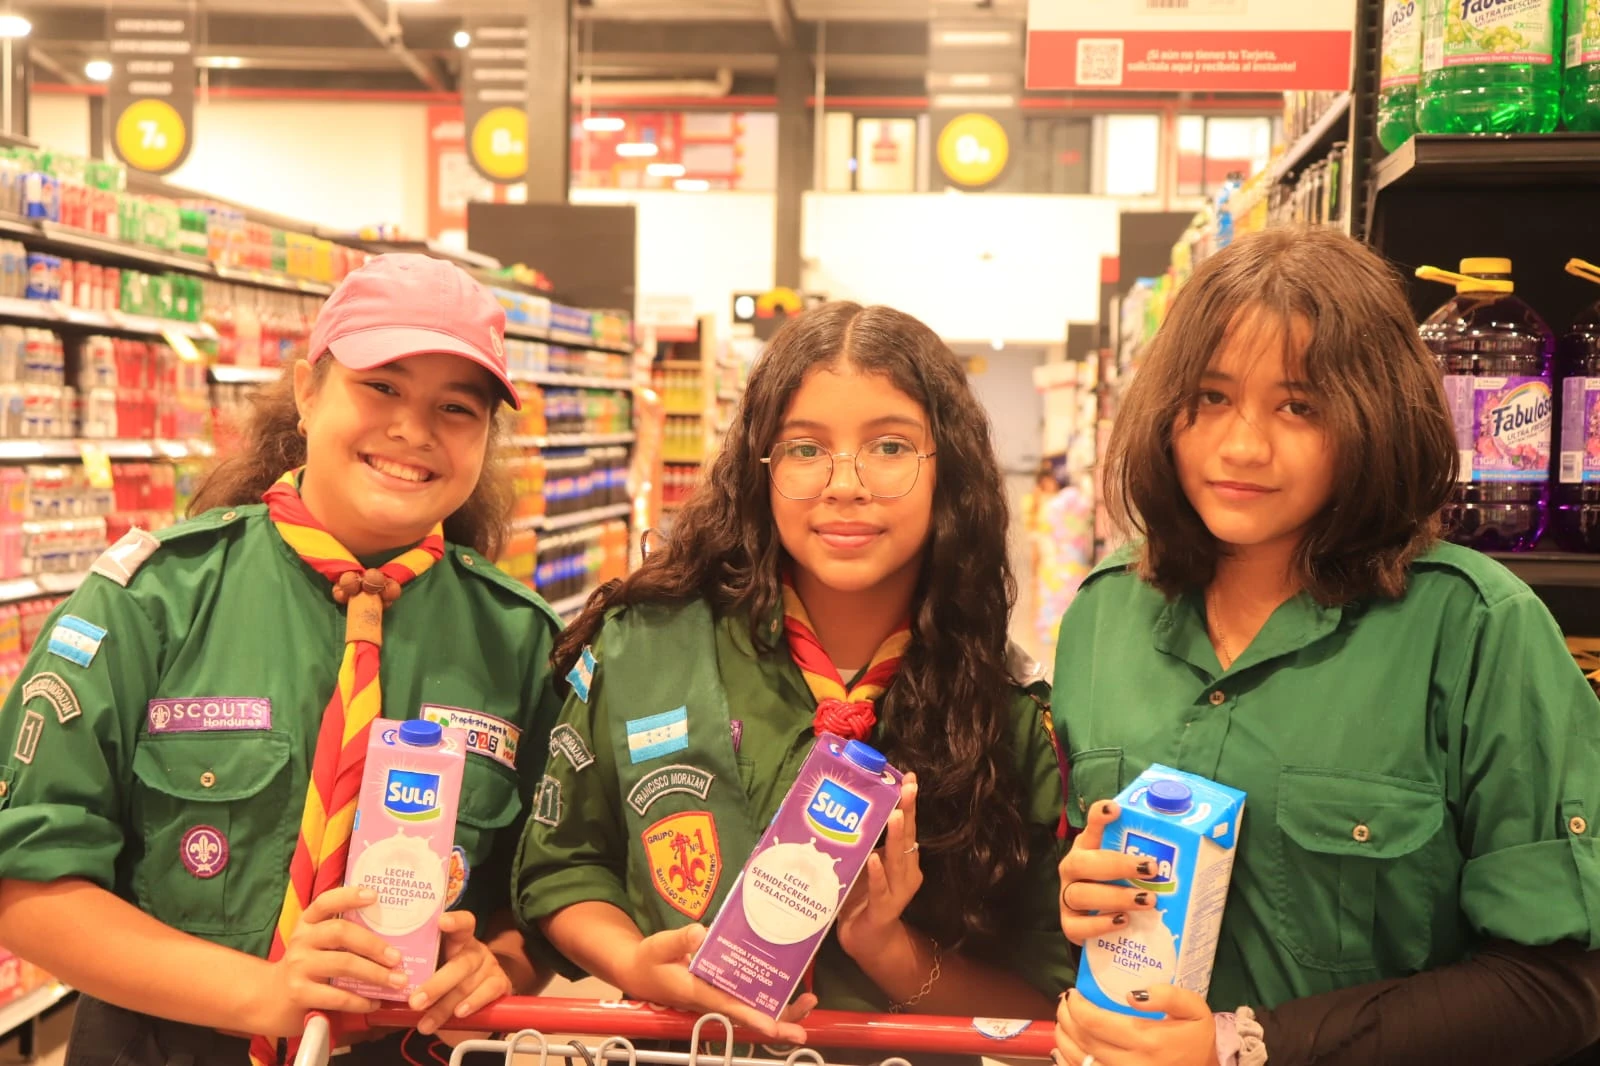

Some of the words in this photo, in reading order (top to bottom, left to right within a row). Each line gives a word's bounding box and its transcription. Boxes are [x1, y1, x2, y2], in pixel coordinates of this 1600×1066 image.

[1195, 49, 1225, 60] tienes
[173, 703, 262, 719] SCOUTS
[203, 717, 262, 728] Honduras
[388, 782, 436, 807] SULA
[635, 774, 669, 807] FRANCISCO
[670, 773, 706, 791] MORAZAN
[812, 791, 860, 831] SULA
[647, 829, 674, 845] GRUPO
[385, 867, 416, 879] LECHE
[364, 874, 433, 891] DESCREMADA
[783, 872, 811, 893] LECHE
[753, 879, 818, 922] DESLACTOSADA
[1118, 936, 1148, 954] LECHE
[1097, 939, 1163, 970] DESCREMADA
